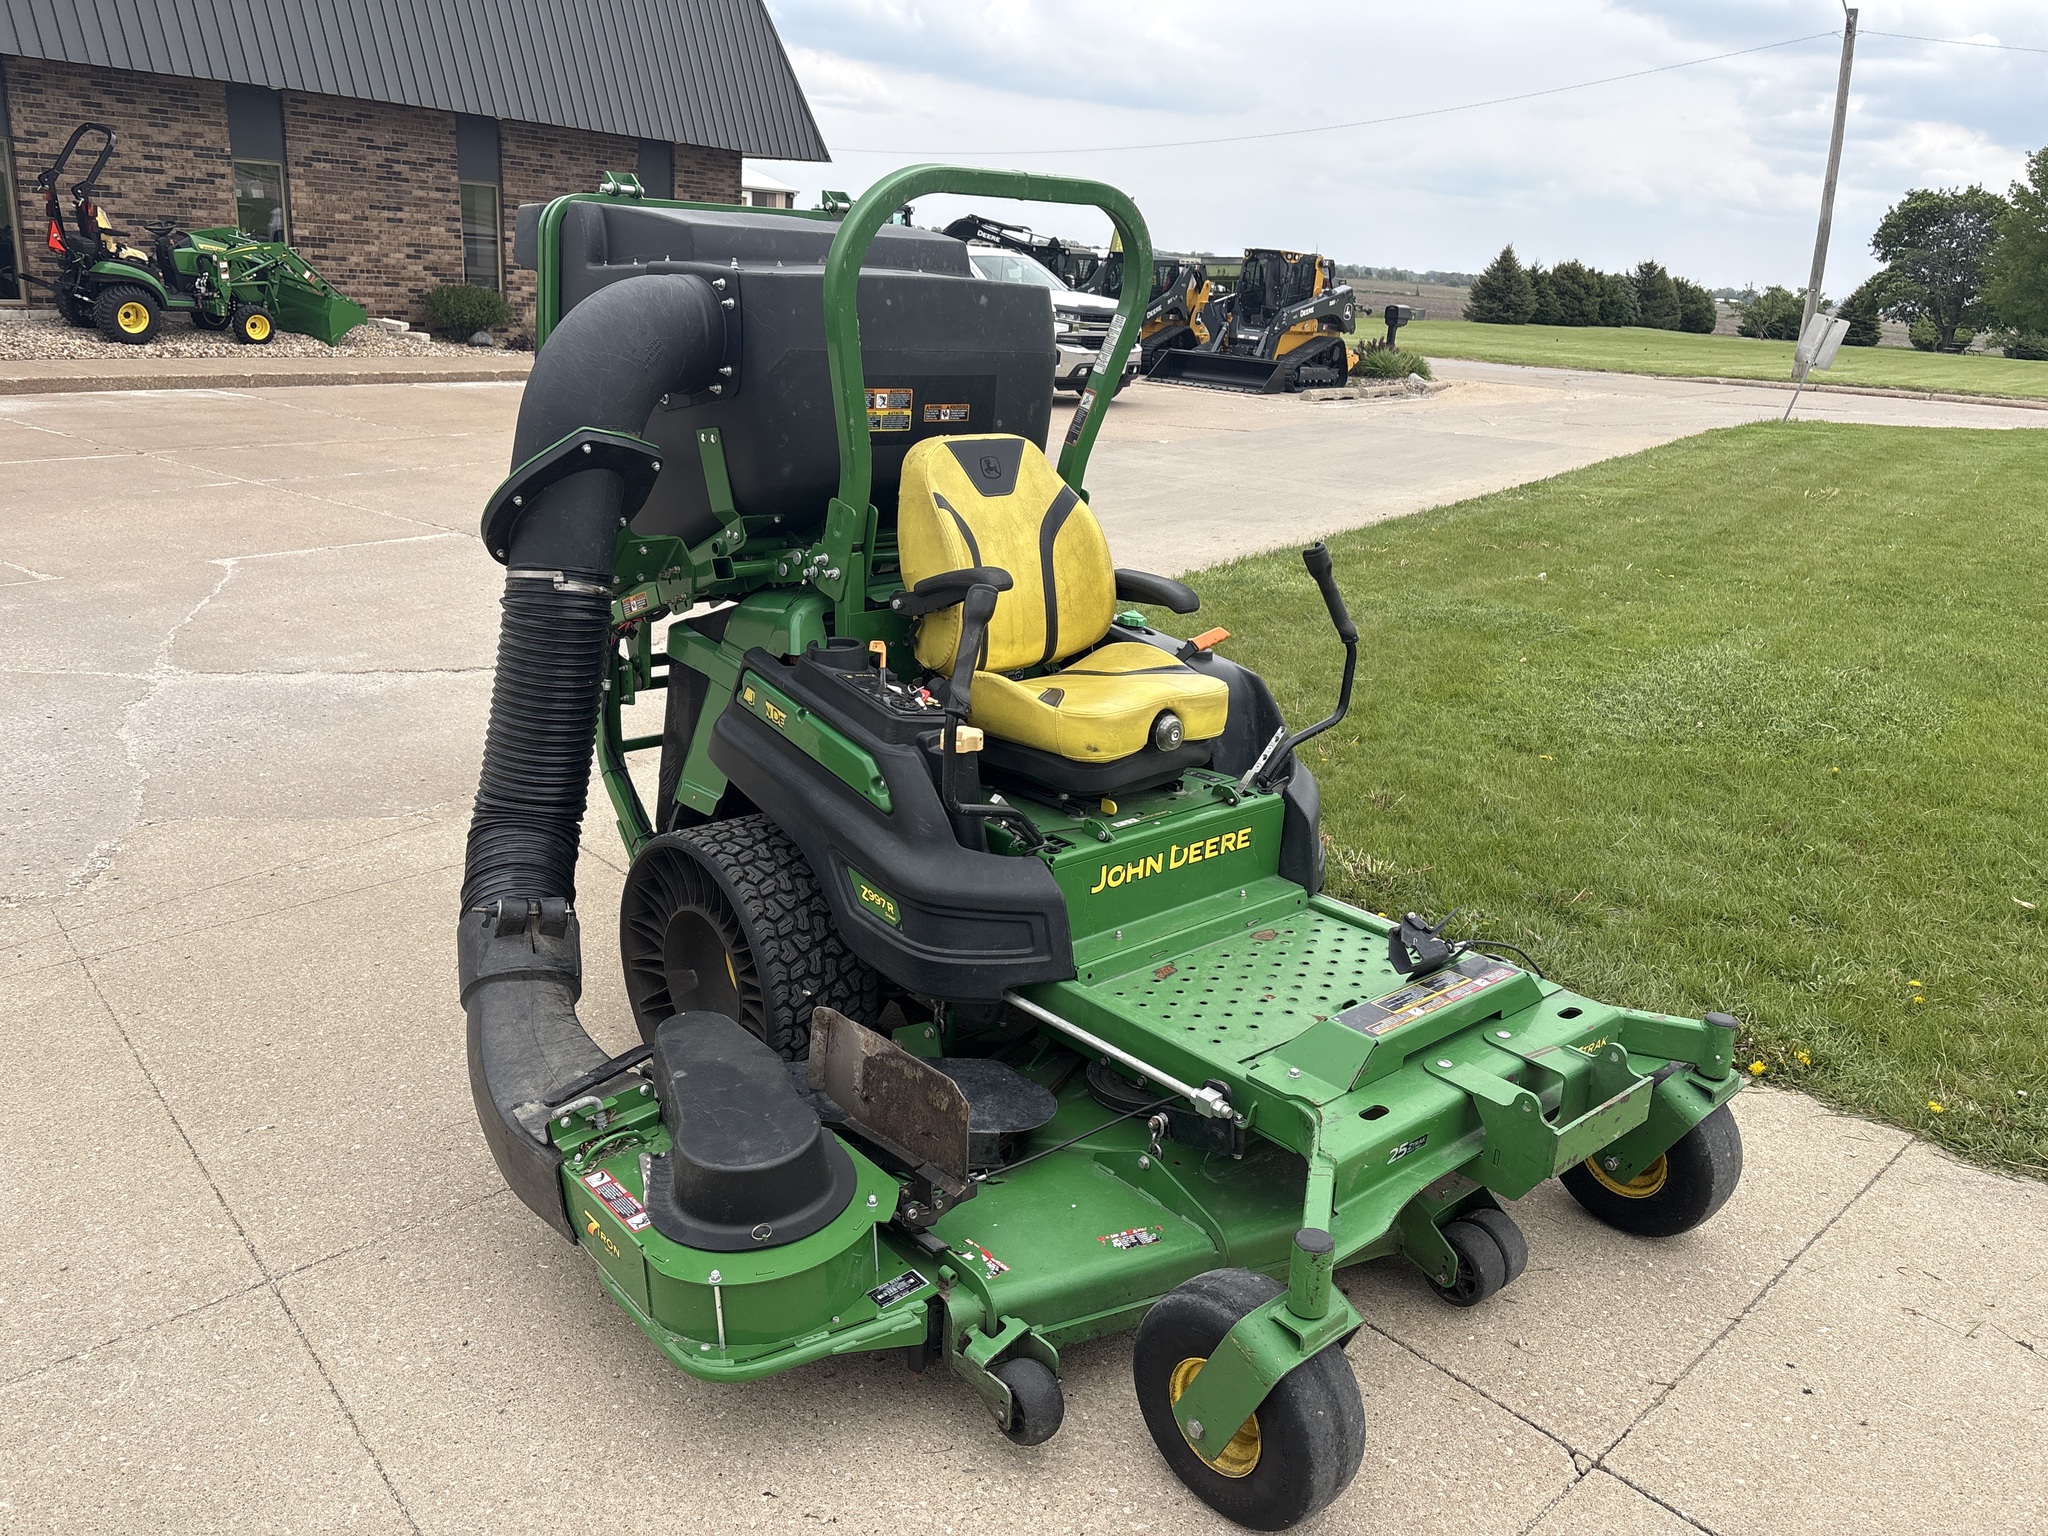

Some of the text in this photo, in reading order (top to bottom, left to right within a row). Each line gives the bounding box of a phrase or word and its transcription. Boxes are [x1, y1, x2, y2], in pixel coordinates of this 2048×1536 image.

[976, 229, 1001, 243] DEERE
[1090, 826, 1252, 895] JOHN DEERE
[1386, 1141, 1409, 1166] 25
